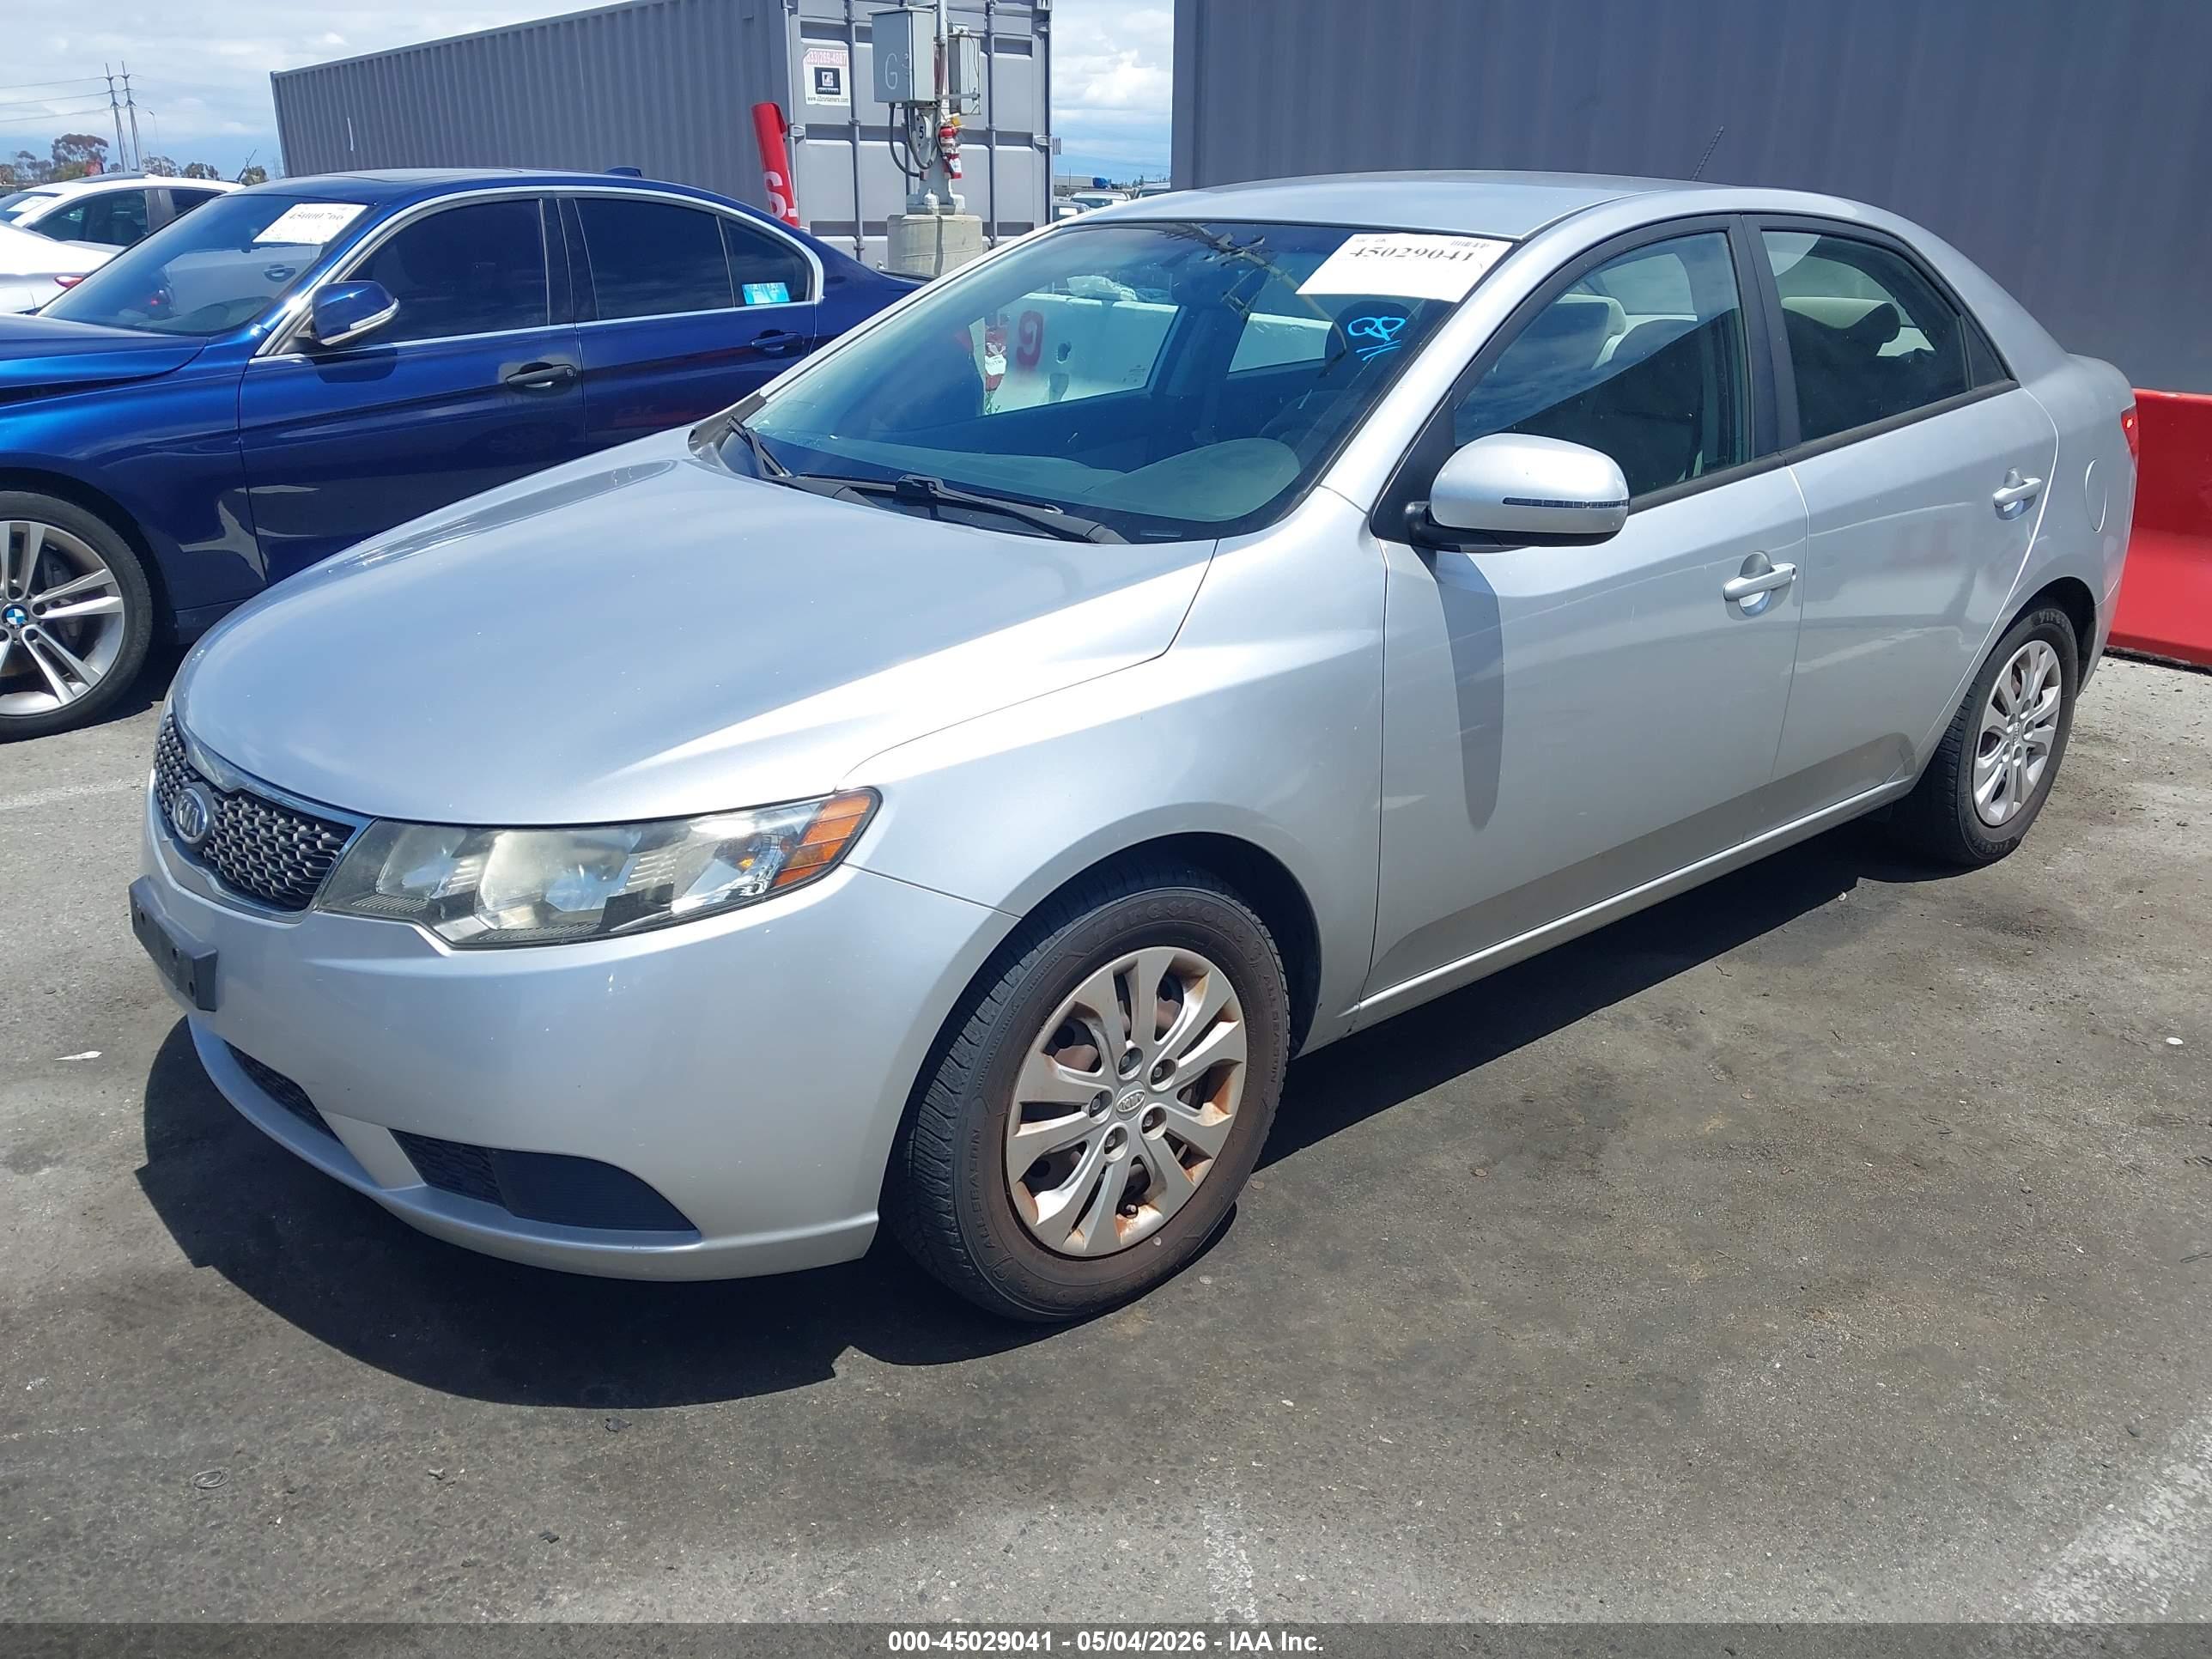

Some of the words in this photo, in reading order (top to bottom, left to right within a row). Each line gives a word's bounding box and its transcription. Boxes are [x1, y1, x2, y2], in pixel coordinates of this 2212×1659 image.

[884, 53, 898, 90] G
[919, 126, 924, 139] 5
[1349, 246, 1474, 261] 45029041
[1016, 310, 1044, 368] 9
